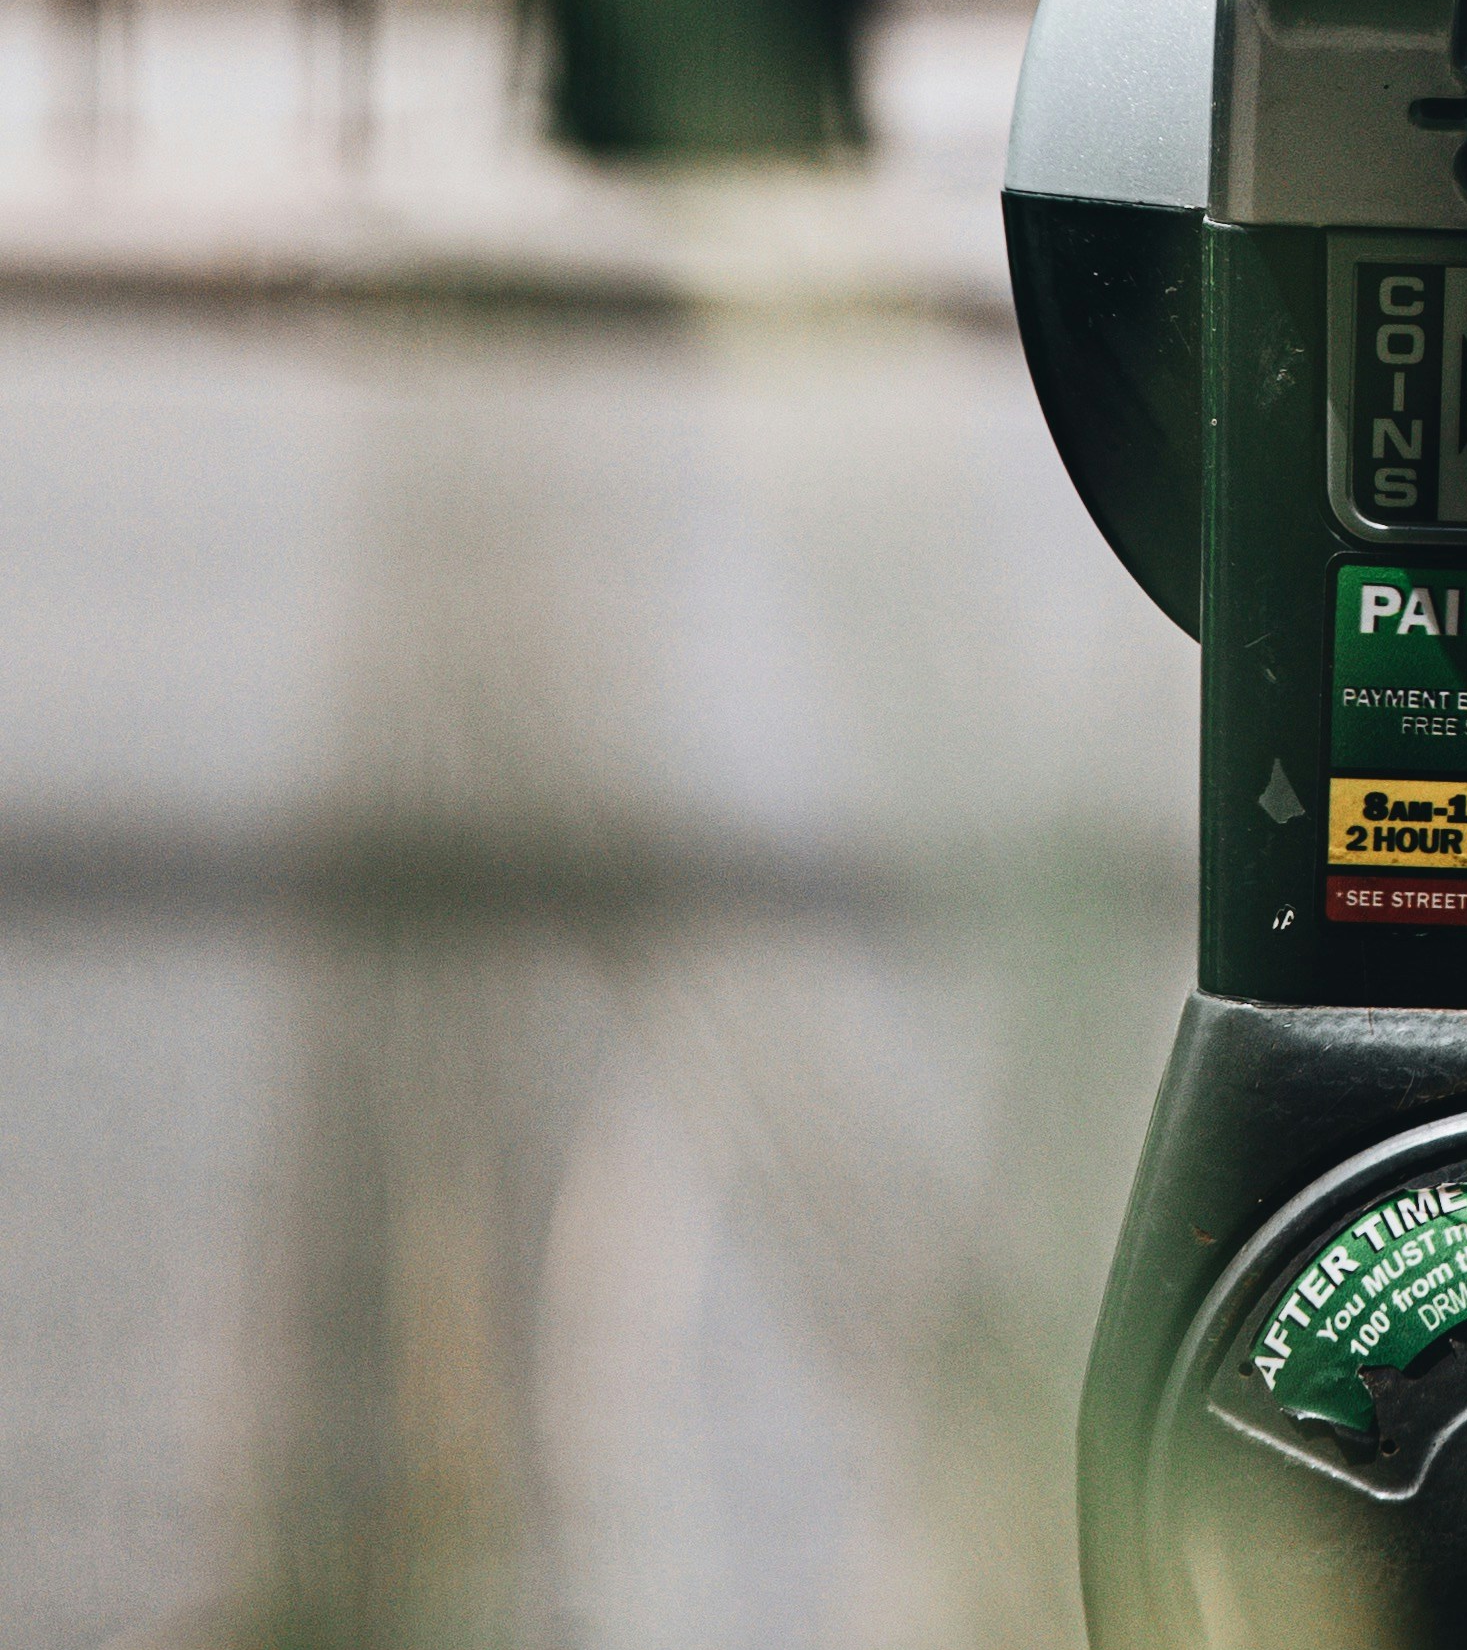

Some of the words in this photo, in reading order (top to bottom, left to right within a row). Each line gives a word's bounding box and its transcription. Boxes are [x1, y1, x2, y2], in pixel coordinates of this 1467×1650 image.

[1371, 275, 1426, 509] COINS
[1343, 687, 1452, 711] PAYMENT
[1401, 717, 1459, 738] FREE
[1346, 826, 1368, 851] 2
[1374, 827, 1460, 854] HOUR
[1316, 1293, 1365, 1343] You
[1361, 1228, 1436, 1300] MUST
[1391, 1262, 1456, 1314] from
[1254, 1245, 1361, 1391] AFTER
